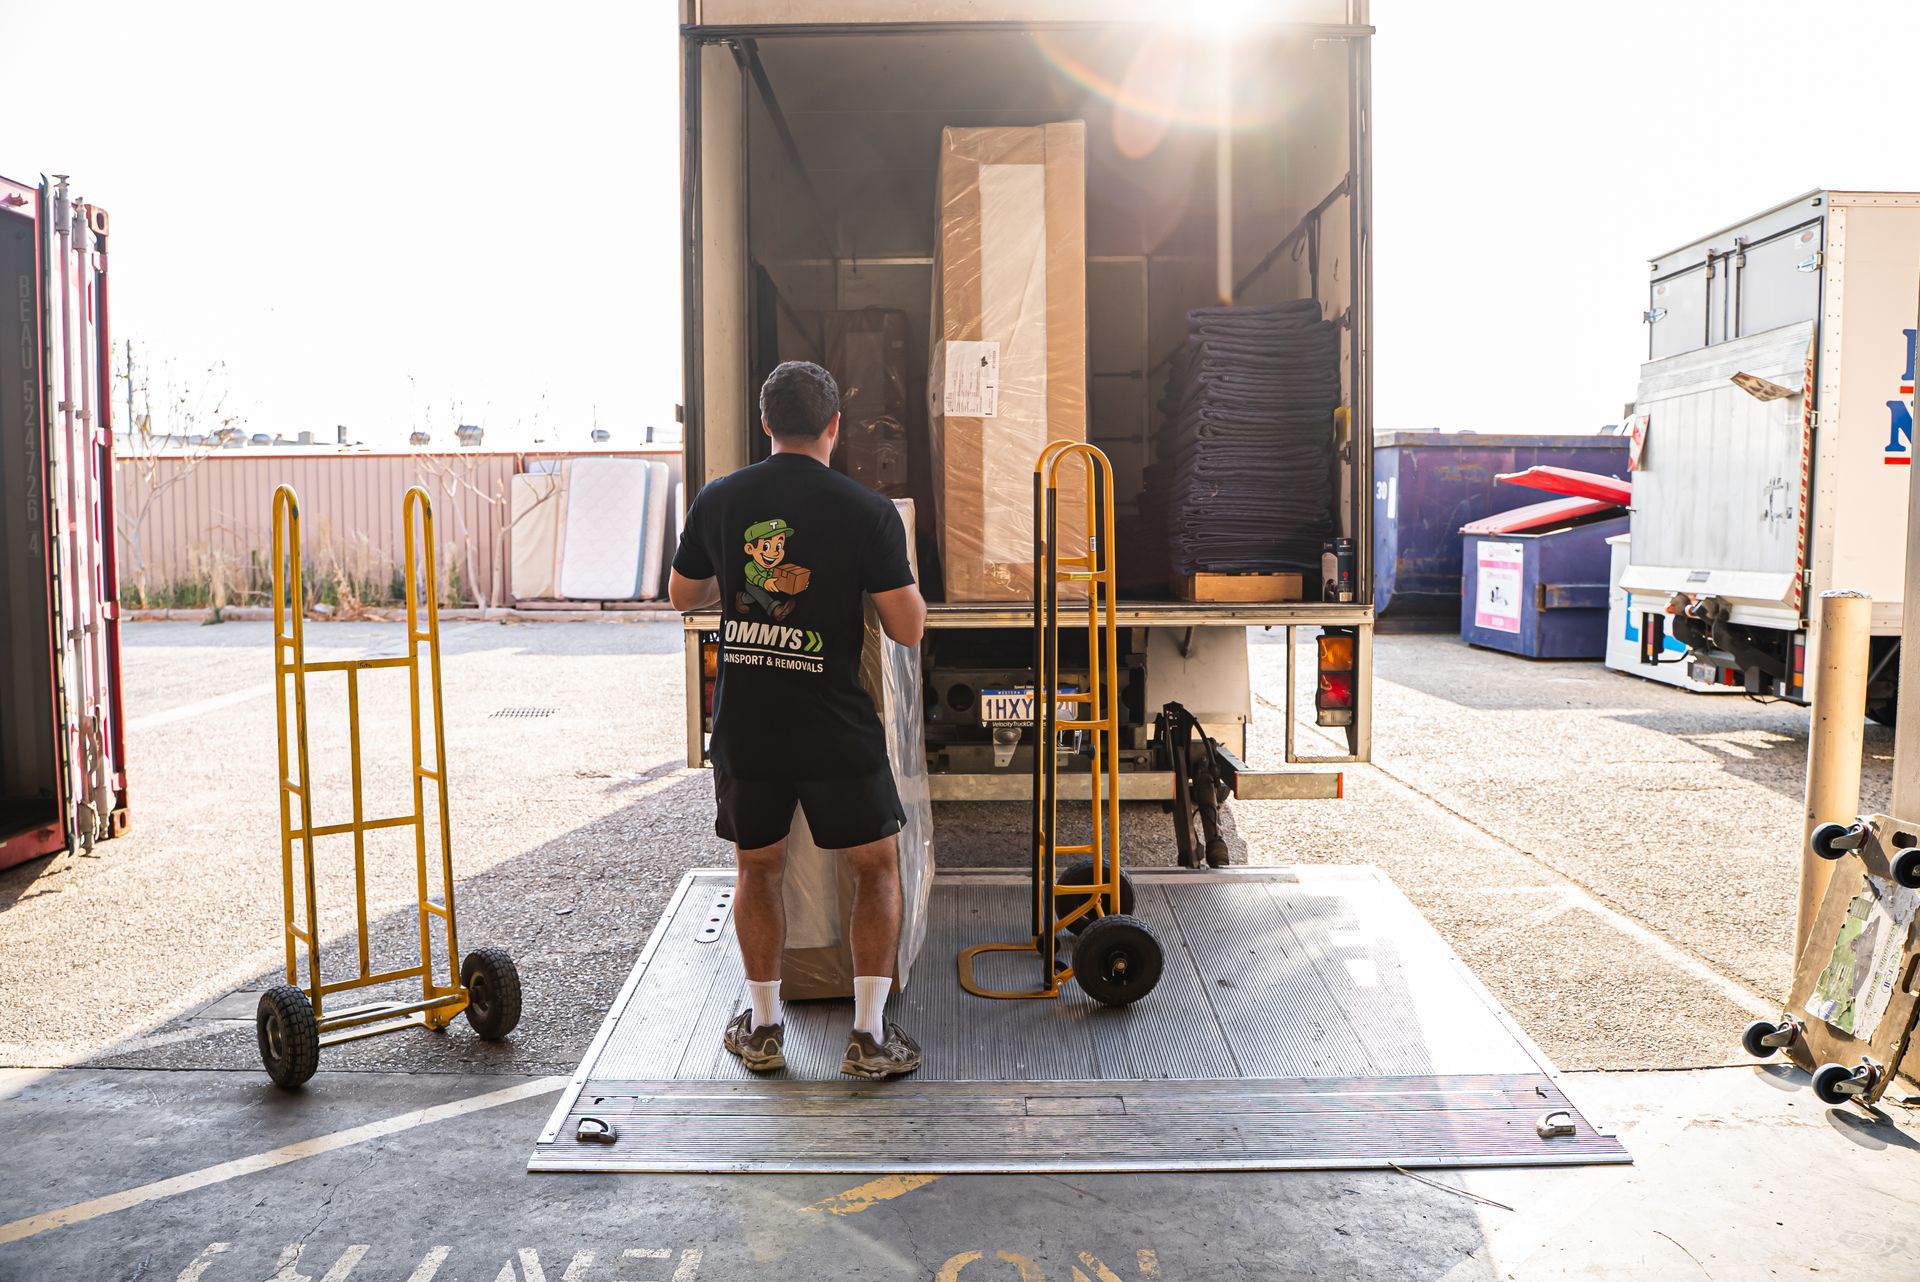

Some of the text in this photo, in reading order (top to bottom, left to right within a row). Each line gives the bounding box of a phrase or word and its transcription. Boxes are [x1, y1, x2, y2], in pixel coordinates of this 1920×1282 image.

[19, 275, 40, 556] BEAU 524726 4
[1376, 480, 1388, 500] 30
[769, 521, 778, 530] T
[725, 620, 803, 650] OMMYS
[724, 652, 824, 673] ANSPORT & REMOVALS
